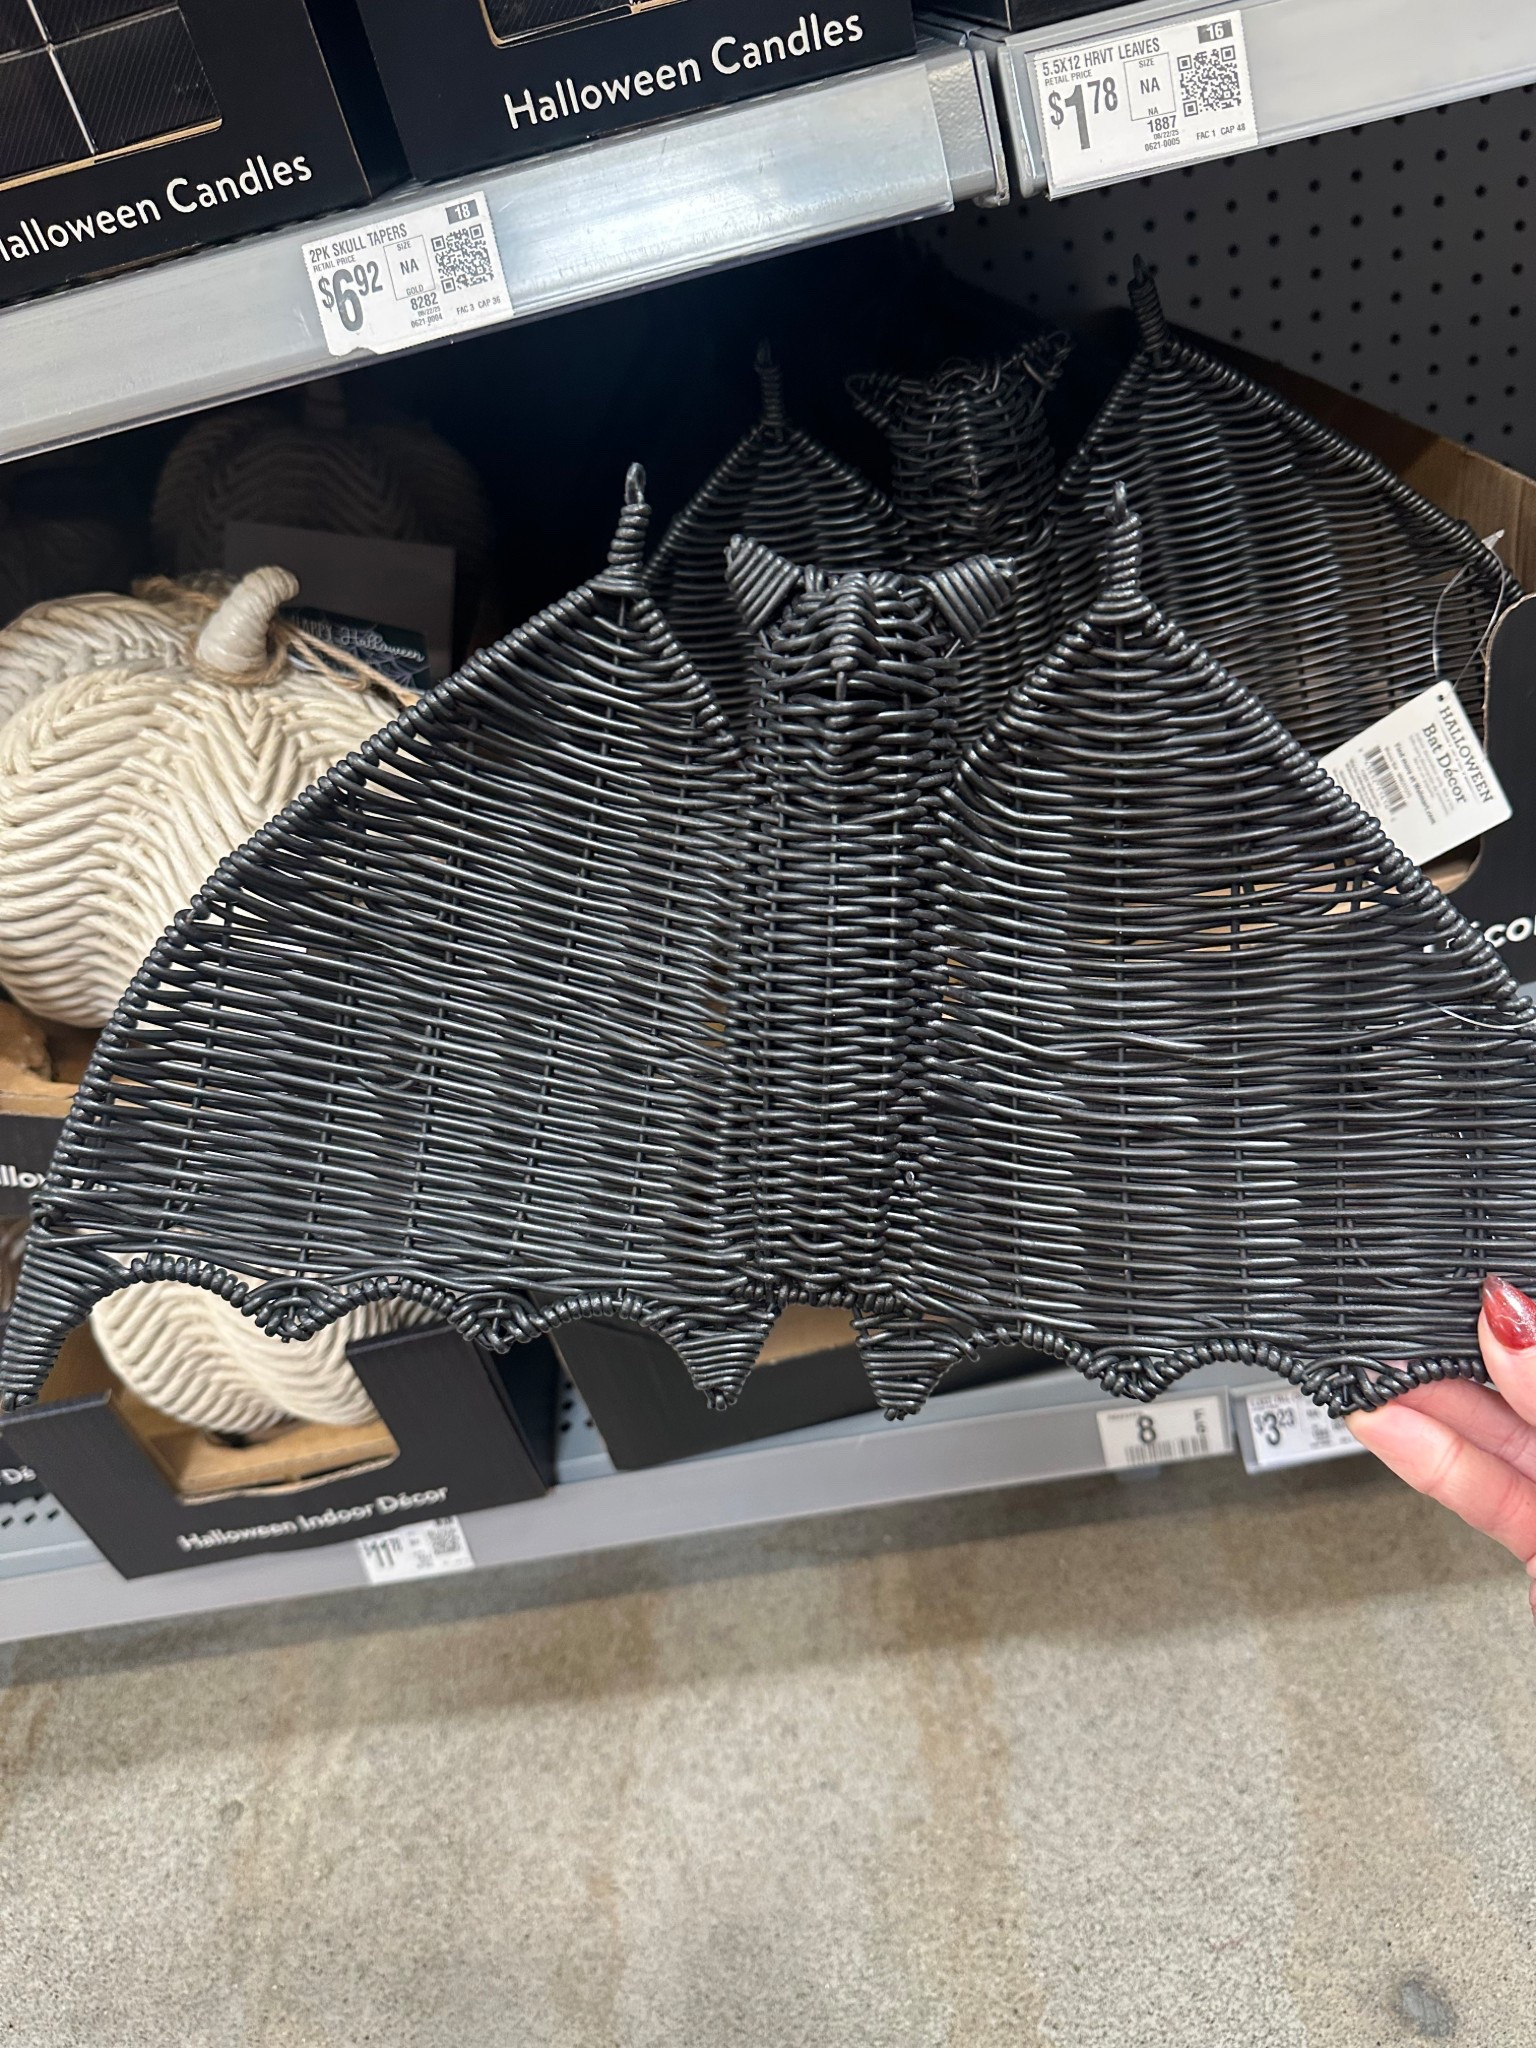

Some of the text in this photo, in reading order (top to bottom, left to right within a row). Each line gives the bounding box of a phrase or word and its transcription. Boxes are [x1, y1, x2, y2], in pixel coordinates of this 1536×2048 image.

[1205, 24, 1225, 40] 16
[1042, 37, 1161, 77] 5.5X12 HRVT LEAVES
[1138, 58, 1155, 68] SIZE
[504, 13, 863, 129] Halloween Candles
[1045, 69, 1092, 86] RETAIL PRICE
[1140, 77, 1160, 95] NA
[1148, 107, 1159, 116] NA
[1147, 115, 1177, 133] 1887
[1196, 131, 1211, 141] FAC
[1220, 125, 1235, 136] CAP
[1145, 137, 1180, 151] 0621-0005
[167, 155, 312, 213] Candles
[455, 203, 471, 220] 18
[309, 223, 408, 264] 2PK SKULL TAPERS
[396, 241, 412, 252] SIZE
[313, 255, 356, 273] RETAIL PRICE
[400, 259, 420, 276] NA
[406, 284, 424, 296] GOLD
[410, 292, 439, 311] 8282
[456, 305, 470, 315] FAC
[478, 298, 492, 310] CAP
[1422, 722, 1443, 758] Bat
[1436, 754, 1467, 804] Décor
[1439, 705, 1494, 804] HALLOWEEN
[1137, 1415, 1157, 1445] 8
[176, 1485, 449, 1553] Halloween Indoor Décor
